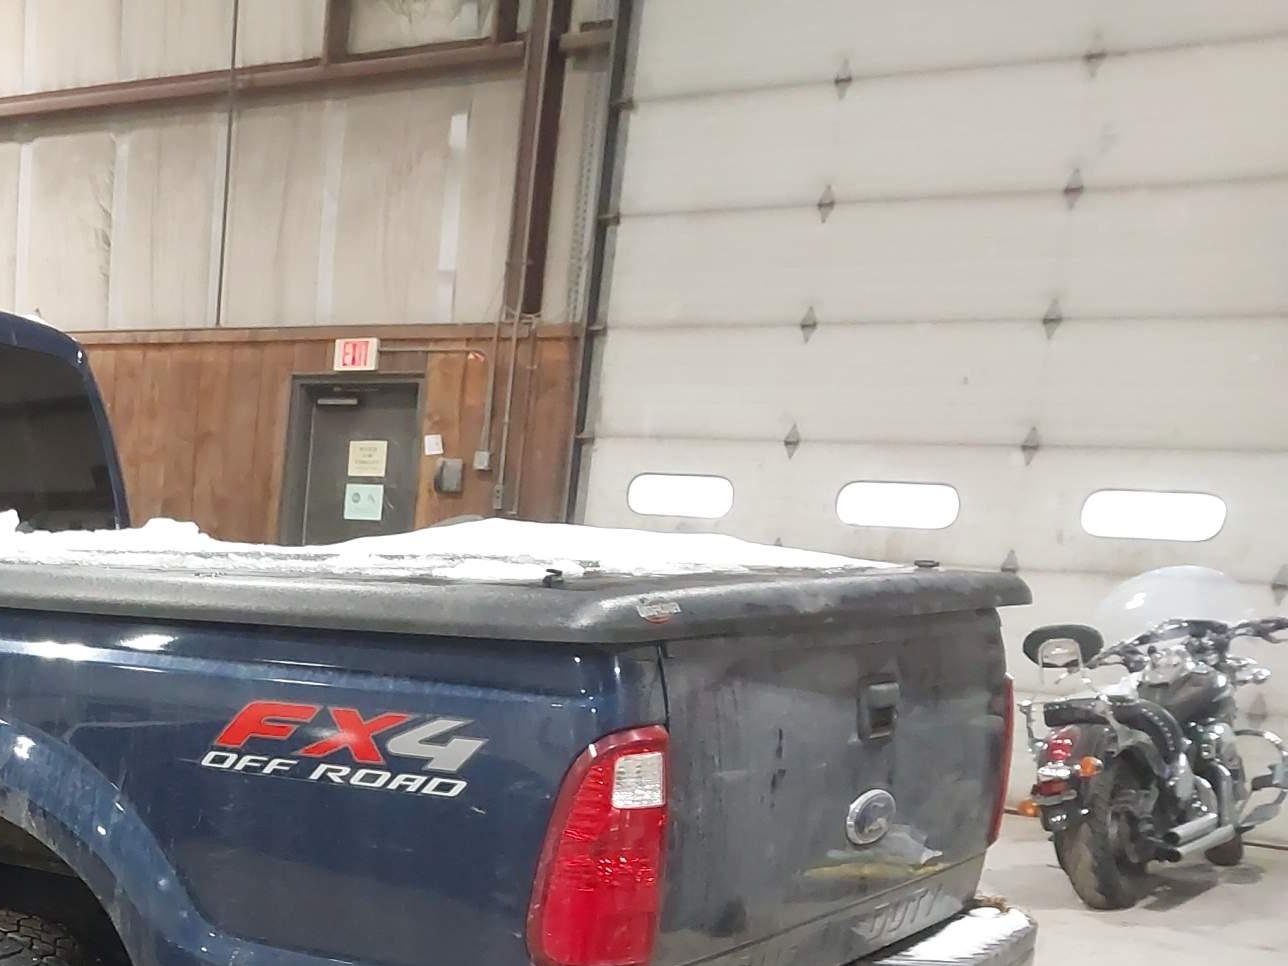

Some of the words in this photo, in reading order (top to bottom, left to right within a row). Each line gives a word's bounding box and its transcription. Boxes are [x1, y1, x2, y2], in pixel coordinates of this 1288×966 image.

[214, 699, 488, 773] FX4
[200, 750, 299, 774] OFF
[309, 763, 469, 798] ROAD
